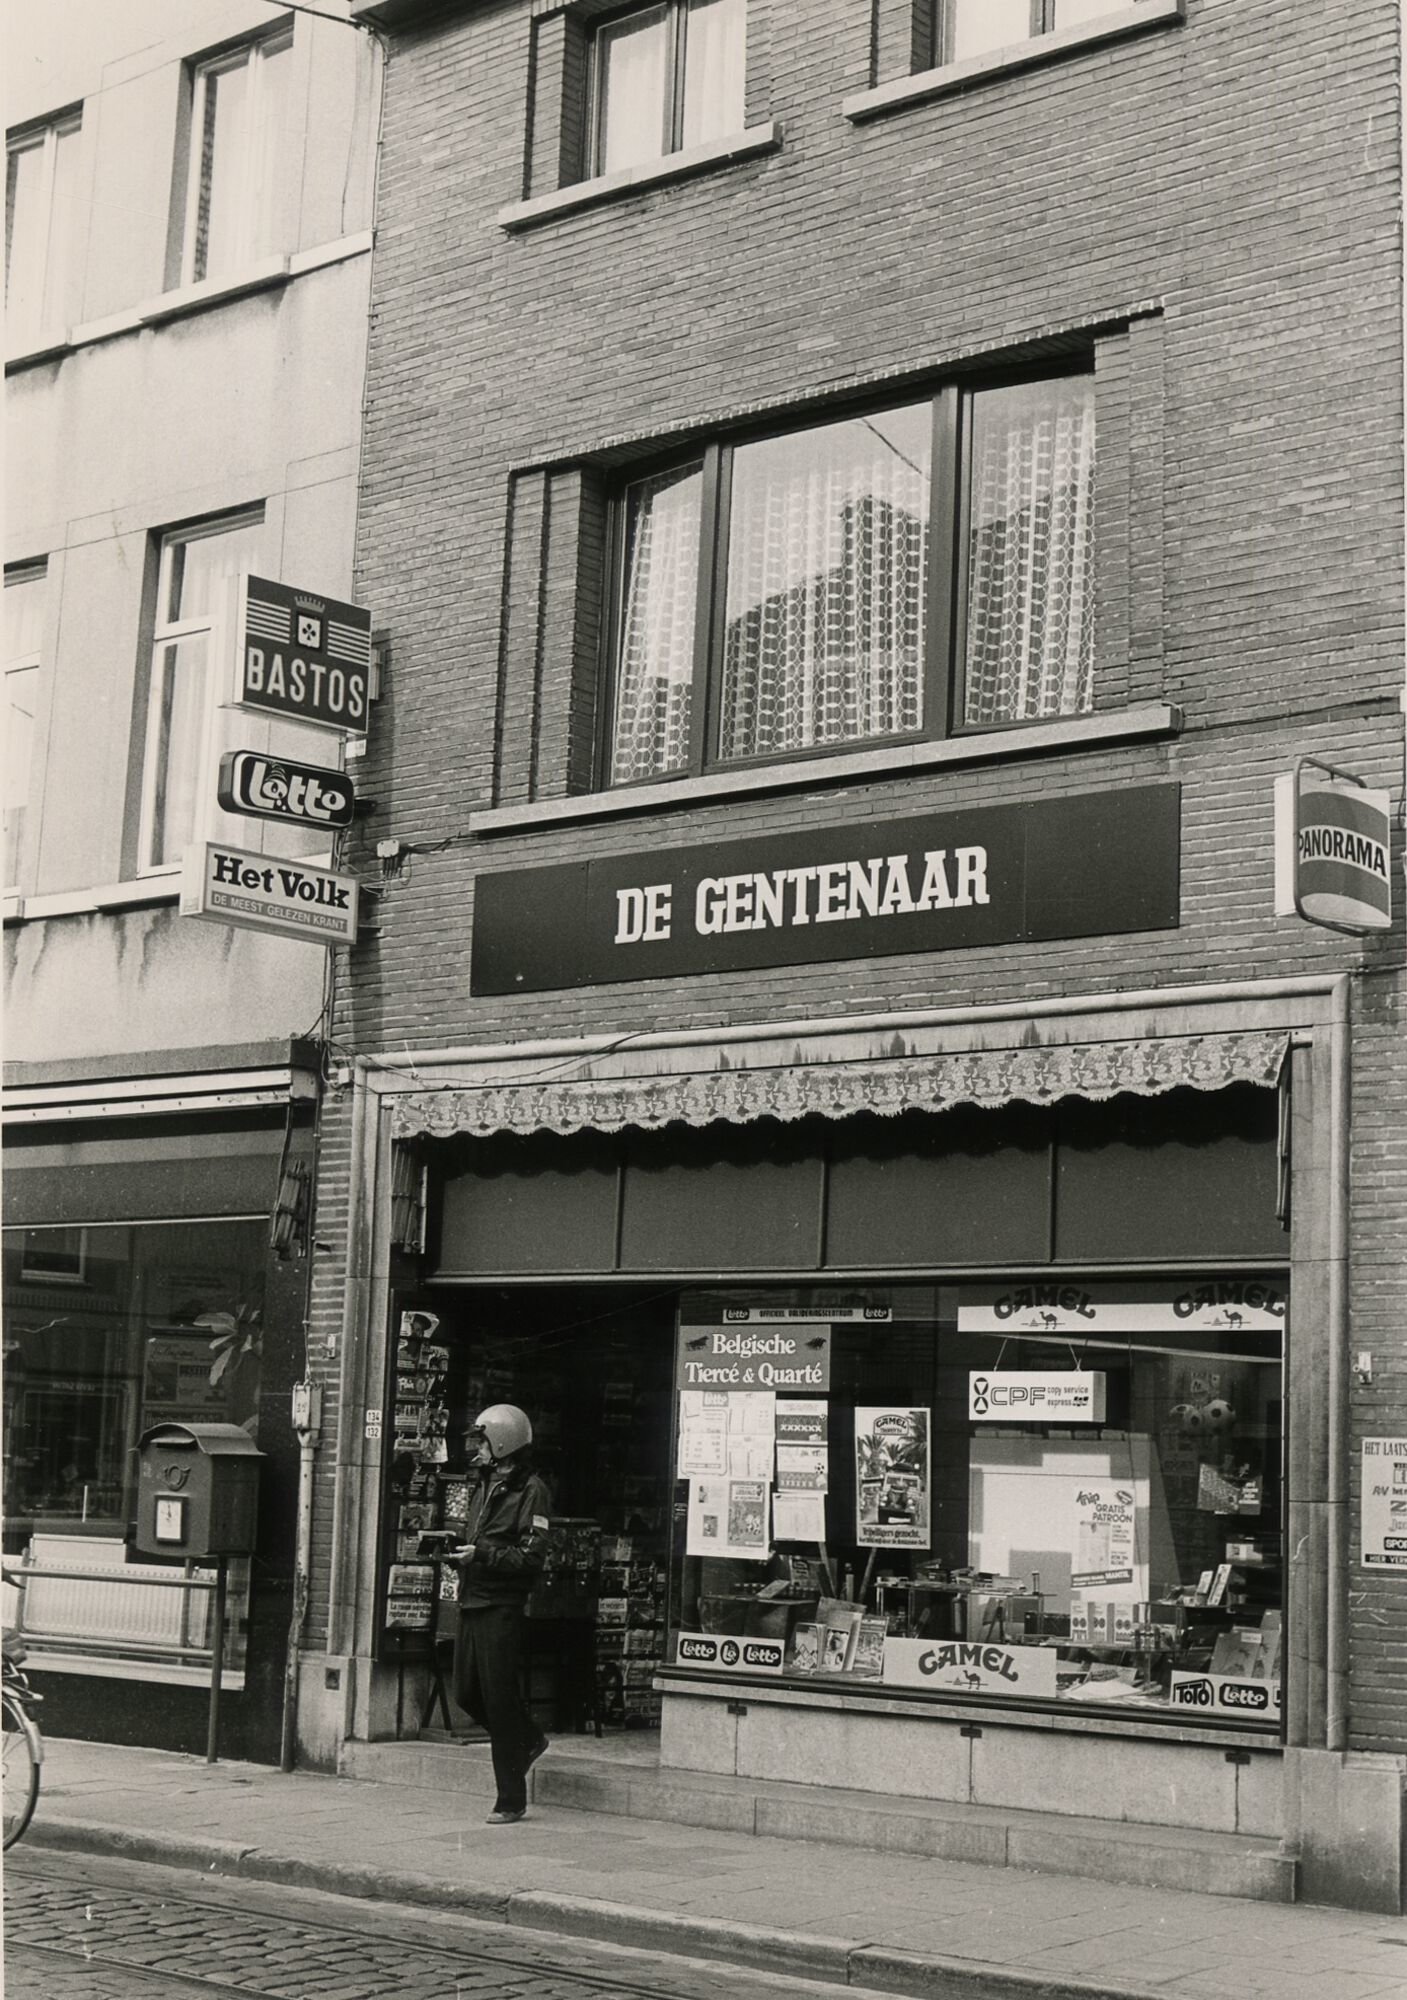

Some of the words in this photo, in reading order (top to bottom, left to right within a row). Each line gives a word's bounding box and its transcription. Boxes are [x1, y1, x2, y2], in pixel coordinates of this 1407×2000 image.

[247, 646, 365, 718] BASTOS
[249, 762, 346, 820] Lotto
[212, 854, 275, 892] Het
[277, 869, 350, 910] Volk
[614, 884, 673, 945] DE
[694, 845, 990, 935] GENTENAAR
[213, 893, 229, 907] DE
[230, 896, 265, 917] MEEST
[267, 903, 311, 924] GELEZEN
[312, 912, 347, 931] KRANT
[993, 1286, 1096, 1319] CAMEL
[1172, 1283, 1286, 1318] CAMEL
[711, 1333, 796, 1358] Belgische
[685, 1360, 739, 1384] Tiercé
[742, 1365, 755, 1384] &
[758, 1361, 823, 1386] Quarté
[990, 1386, 1046, 1406] CPF
[1047, 1386, 1062, 1396] copy
[1064, 1385, 1089, 1394] service
[876, 1417, 907, 1430] CAMEL
[1092, 1512, 1133, 1523] PATROON
[1095, 1503, 1126, 1514] GRATIS
[682, 1640, 715, 1658] Lotto
[746, 1645, 780, 1664] Lotto
[918, 1642, 1019, 1683] CAMEL
[1223, 1686, 1266, 1706] Lotto
